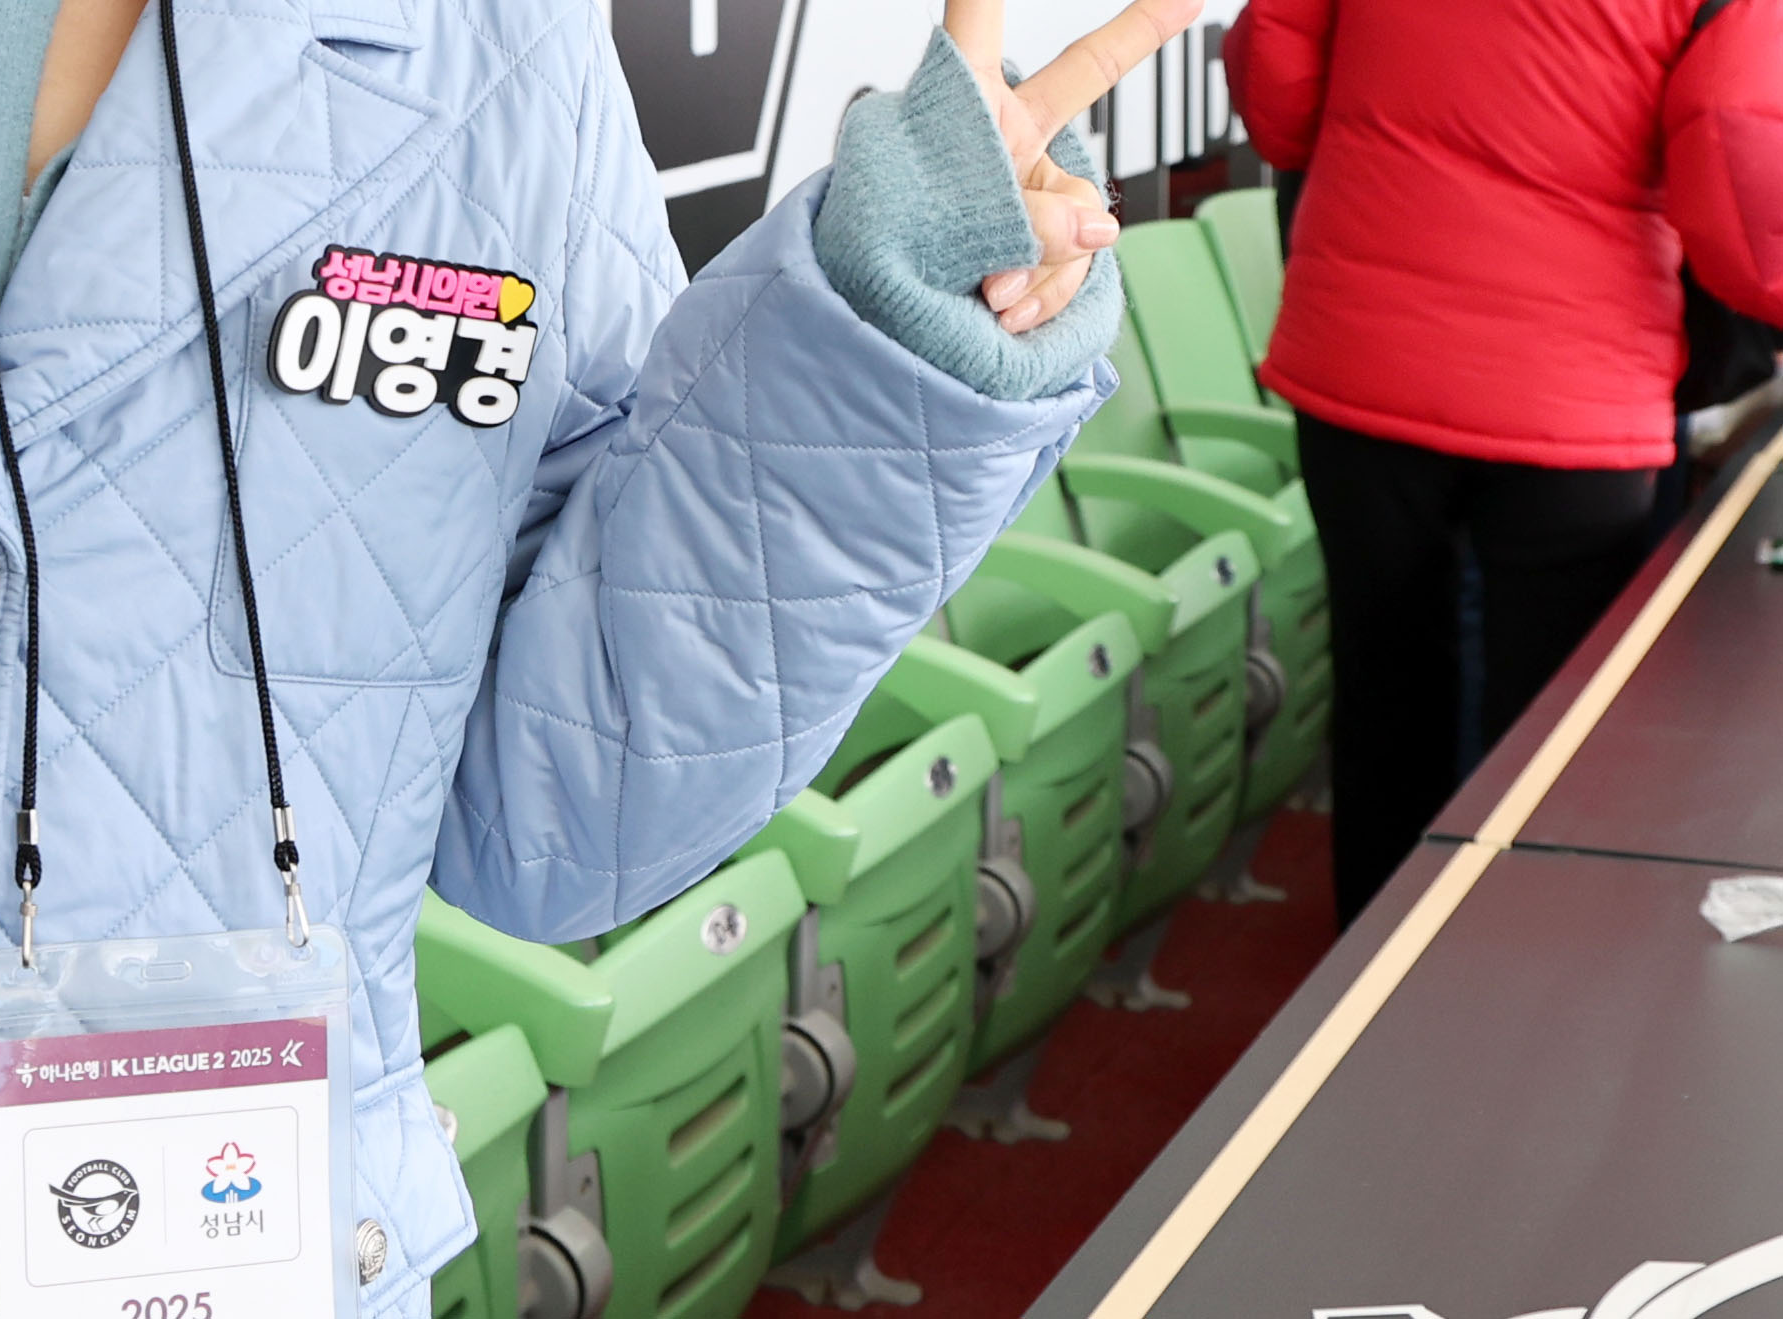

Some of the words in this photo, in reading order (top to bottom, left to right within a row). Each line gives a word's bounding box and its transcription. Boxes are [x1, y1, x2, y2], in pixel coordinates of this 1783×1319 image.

[321, 251, 503, 320] 성남시의원
[275, 294, 538, 426] 이영경
[39, 1060, 100, 1084] 하나은행
[110, 1058, 129, 1077] K
[132, 1053, 210, 1076] LEAGUE
[212, 1052, 225, 1069] 2
[230, 1046, 273, 1068] 2025
[67, 1162, 109, 1188] FOOTBALL
[111, 1165, 132, 1186] CLUB
[60, 1207, 138, 1247] SEONGNAM
[199, 1209, 265, 1240] 성남시
[121, 1291, 213, 1319] 2025
